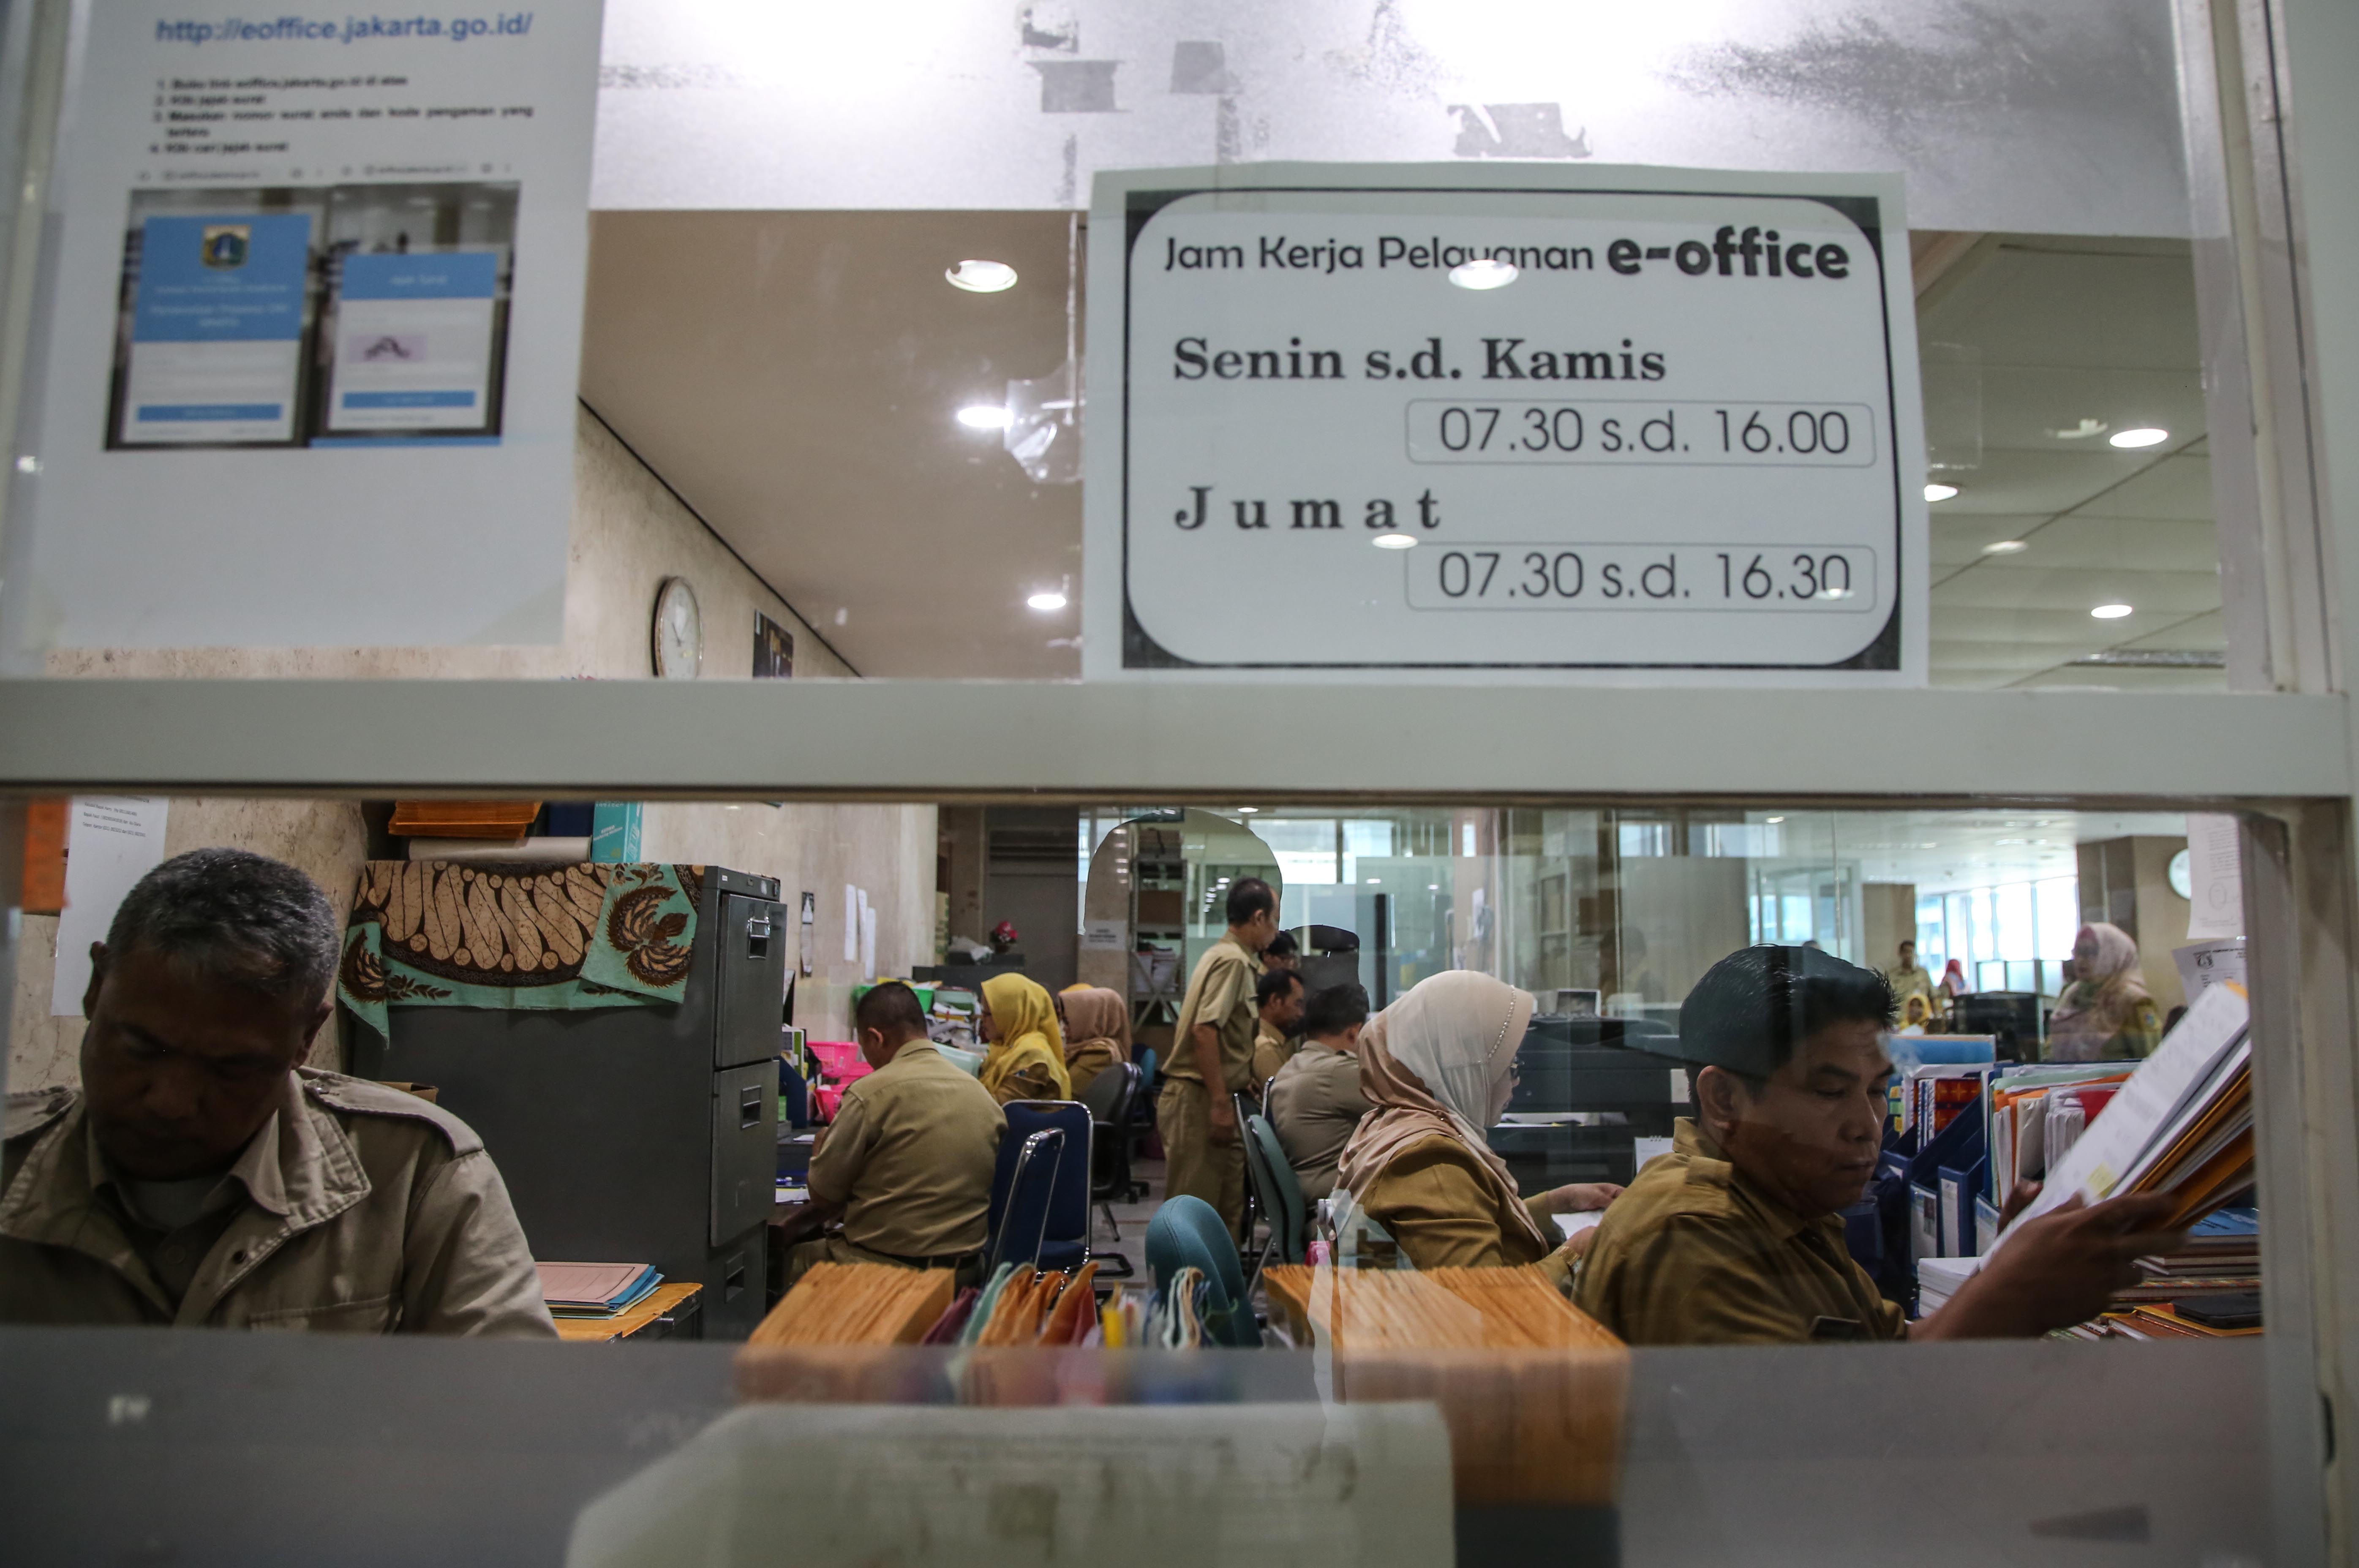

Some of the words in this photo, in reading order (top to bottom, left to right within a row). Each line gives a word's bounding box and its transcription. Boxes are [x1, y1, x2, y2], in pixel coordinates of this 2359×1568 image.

[156, 13, 533, 45] http://eoffice.jakarta.go.id/
[1164, 236, 1244, 271] Jam
[1259, 235, 1363, 275] Kerja
[1607, 226, 1849, 280] e-office
[1174, 337, 1345, 380] Senin
[1365, 337, 1462, 380] s.d.
[1481, 338, 1666, 381] Kamis
[1440, 407, 1583, 452] 07.30
[1601, 409, 1689, 453] s.d.
[1715, 409, 1850, 455] 16.00
[1439, 552, 1583, 598] 07.30
[1602, 554, 1689, 599] s.d.
[1717, 553, 1850, 600] 16.30
